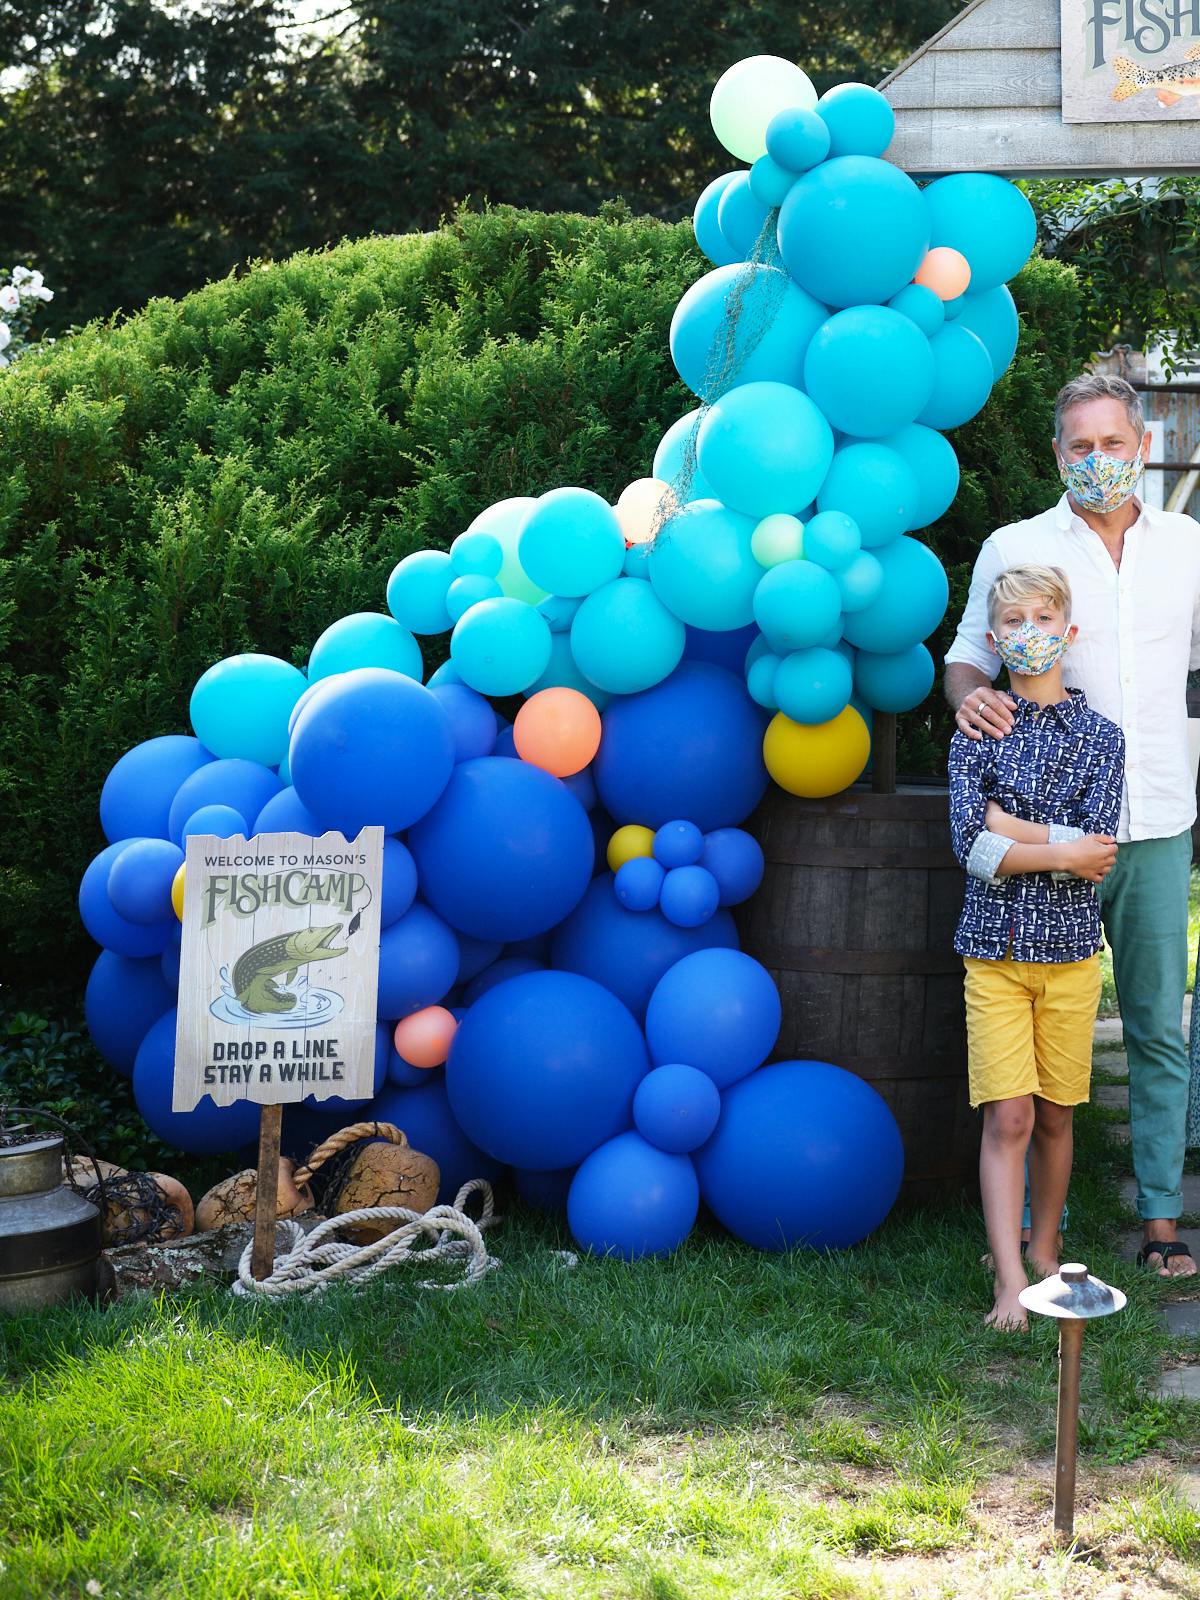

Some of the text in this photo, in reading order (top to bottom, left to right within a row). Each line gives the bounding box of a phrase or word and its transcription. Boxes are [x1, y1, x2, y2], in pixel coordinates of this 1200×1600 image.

[204, 854, 367, 867] WELCOME TO MASON'S
[212, 1039, 339, 1062] DROP A LINE
[203, 1061, 345, 1085] STAY A WHILE
